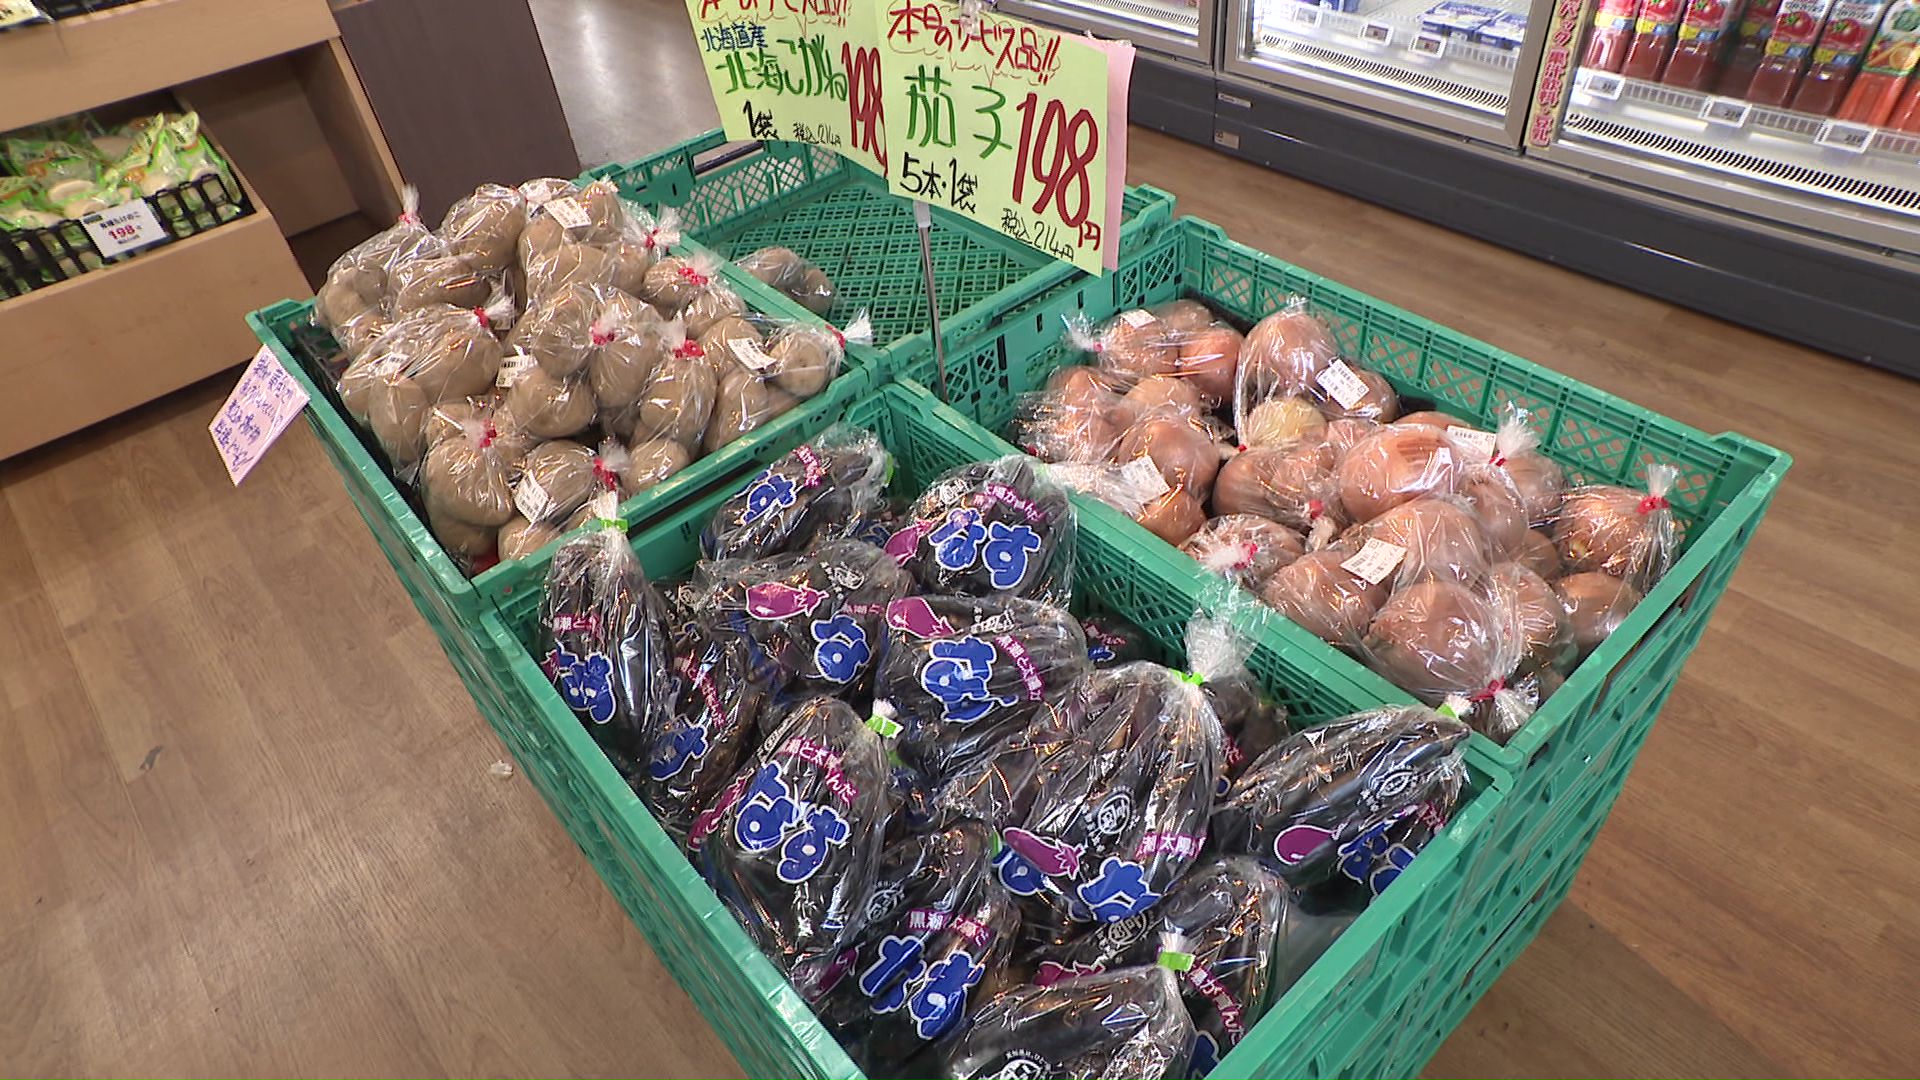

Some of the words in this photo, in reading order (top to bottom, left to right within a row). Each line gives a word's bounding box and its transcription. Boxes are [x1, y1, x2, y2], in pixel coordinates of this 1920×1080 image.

[700, 22, 768, 51] 北海道産
[715, 34, 847, 101] 北海こがね
[742, 100, 780, 140] 1袋
[903, 64, 1013, 159] 茄子
[108, 224, 136, 241] 198
[1001, 207, 1075, 262] 税込214円
[929, 507, 1041, 590] なす
[735, 759, 851, 884] なす
